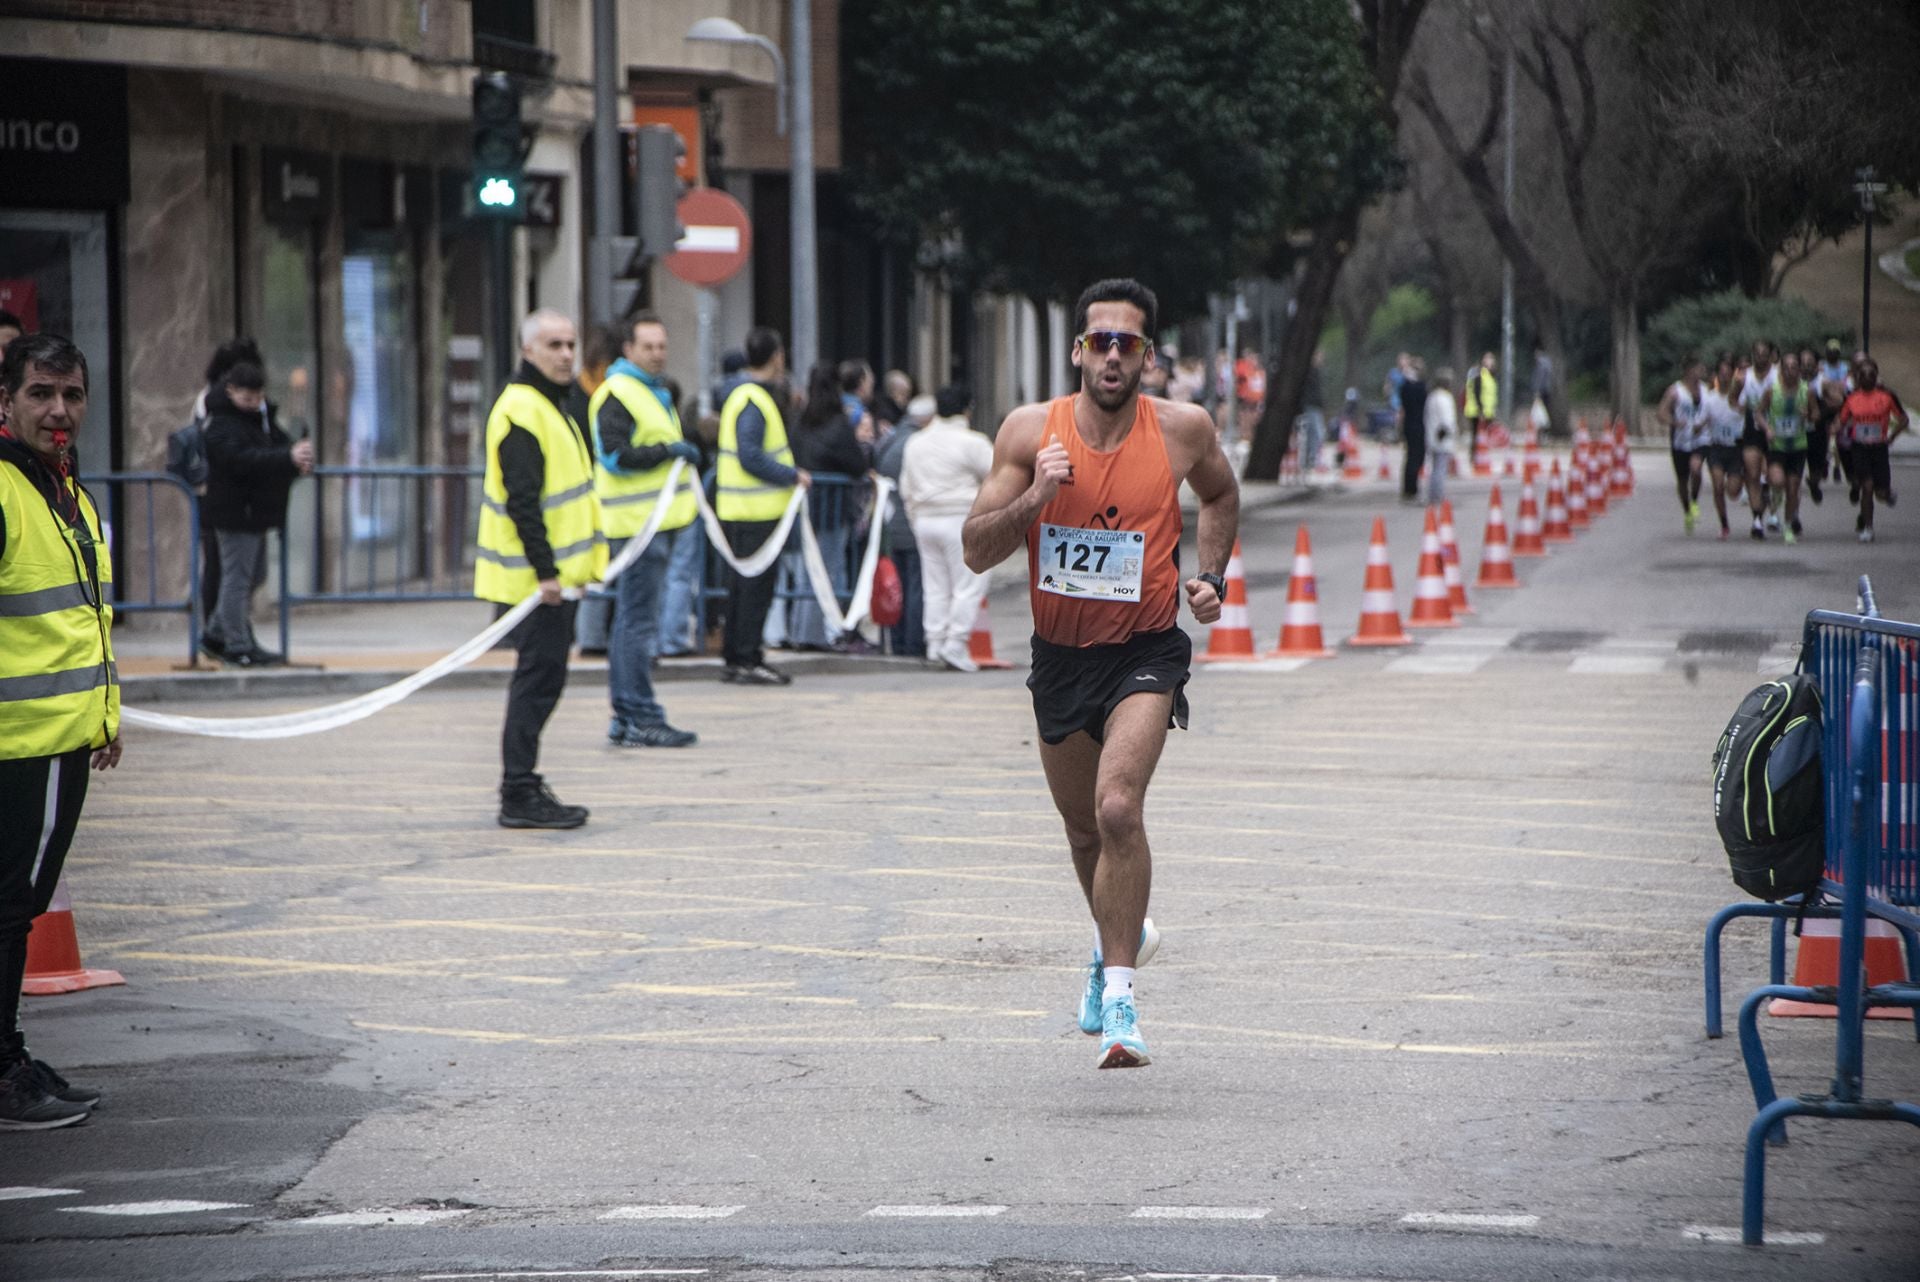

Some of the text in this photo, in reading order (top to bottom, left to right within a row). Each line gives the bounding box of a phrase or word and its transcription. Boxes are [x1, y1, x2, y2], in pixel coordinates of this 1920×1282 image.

[0, 119, 79, 154] nco
[1060, 532, 1082, 540] VUELTA
[1055, 540, 1111, 573] 127
[1114, 586, 1135, 595] HOY
